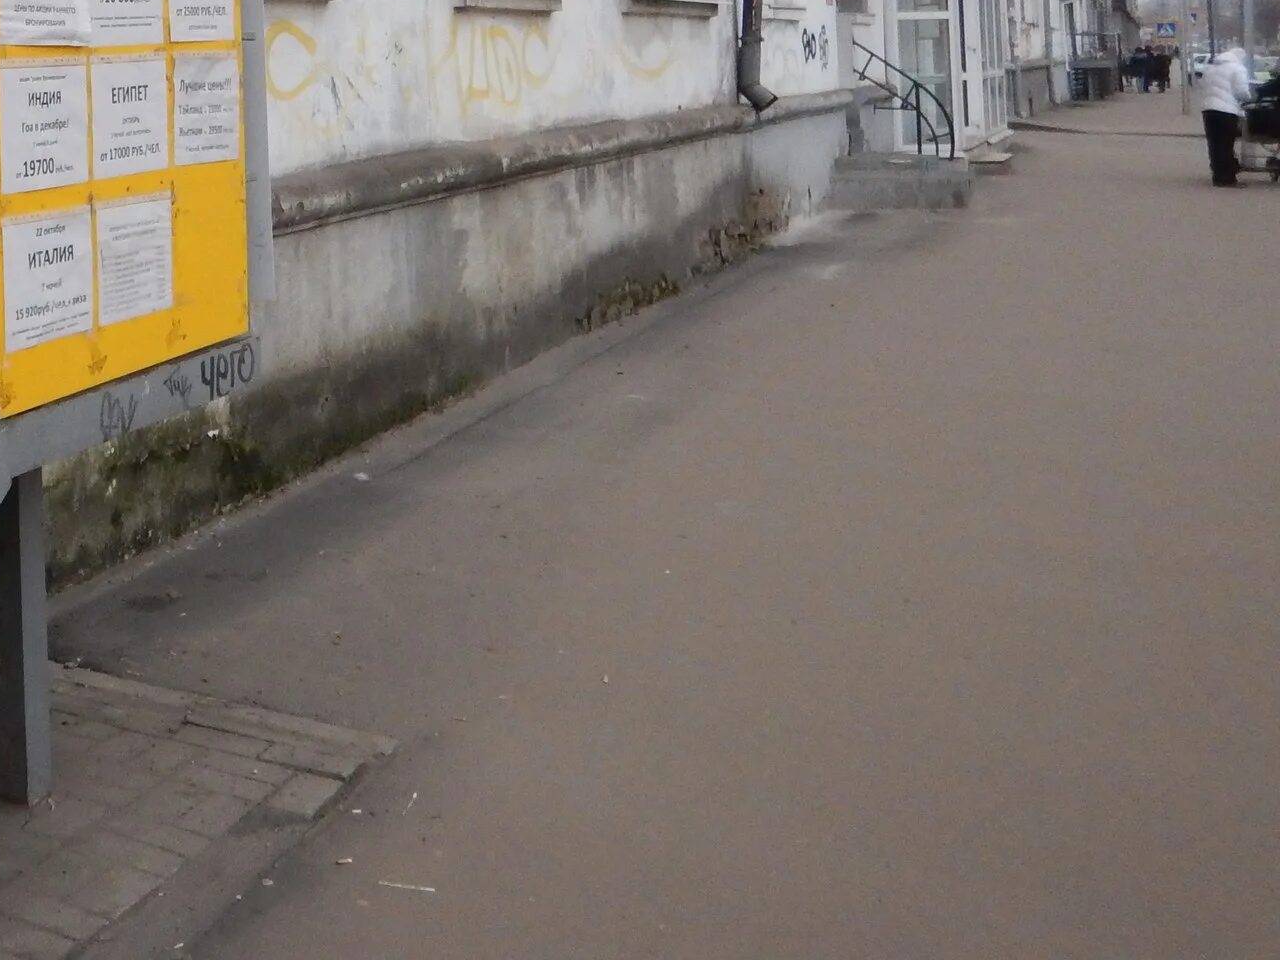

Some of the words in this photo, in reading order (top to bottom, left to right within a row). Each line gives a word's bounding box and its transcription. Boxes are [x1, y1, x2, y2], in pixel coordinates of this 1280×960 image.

[28, 91, 61, 108] ИНДИЯ
[111, 85, 148, 104] ЕГИПЕТ
[40, 118, 69, 131] декабре!
[23, 157, 54, 178] 19700
[28, 244, 74, 270] ИТАЛИЯ
